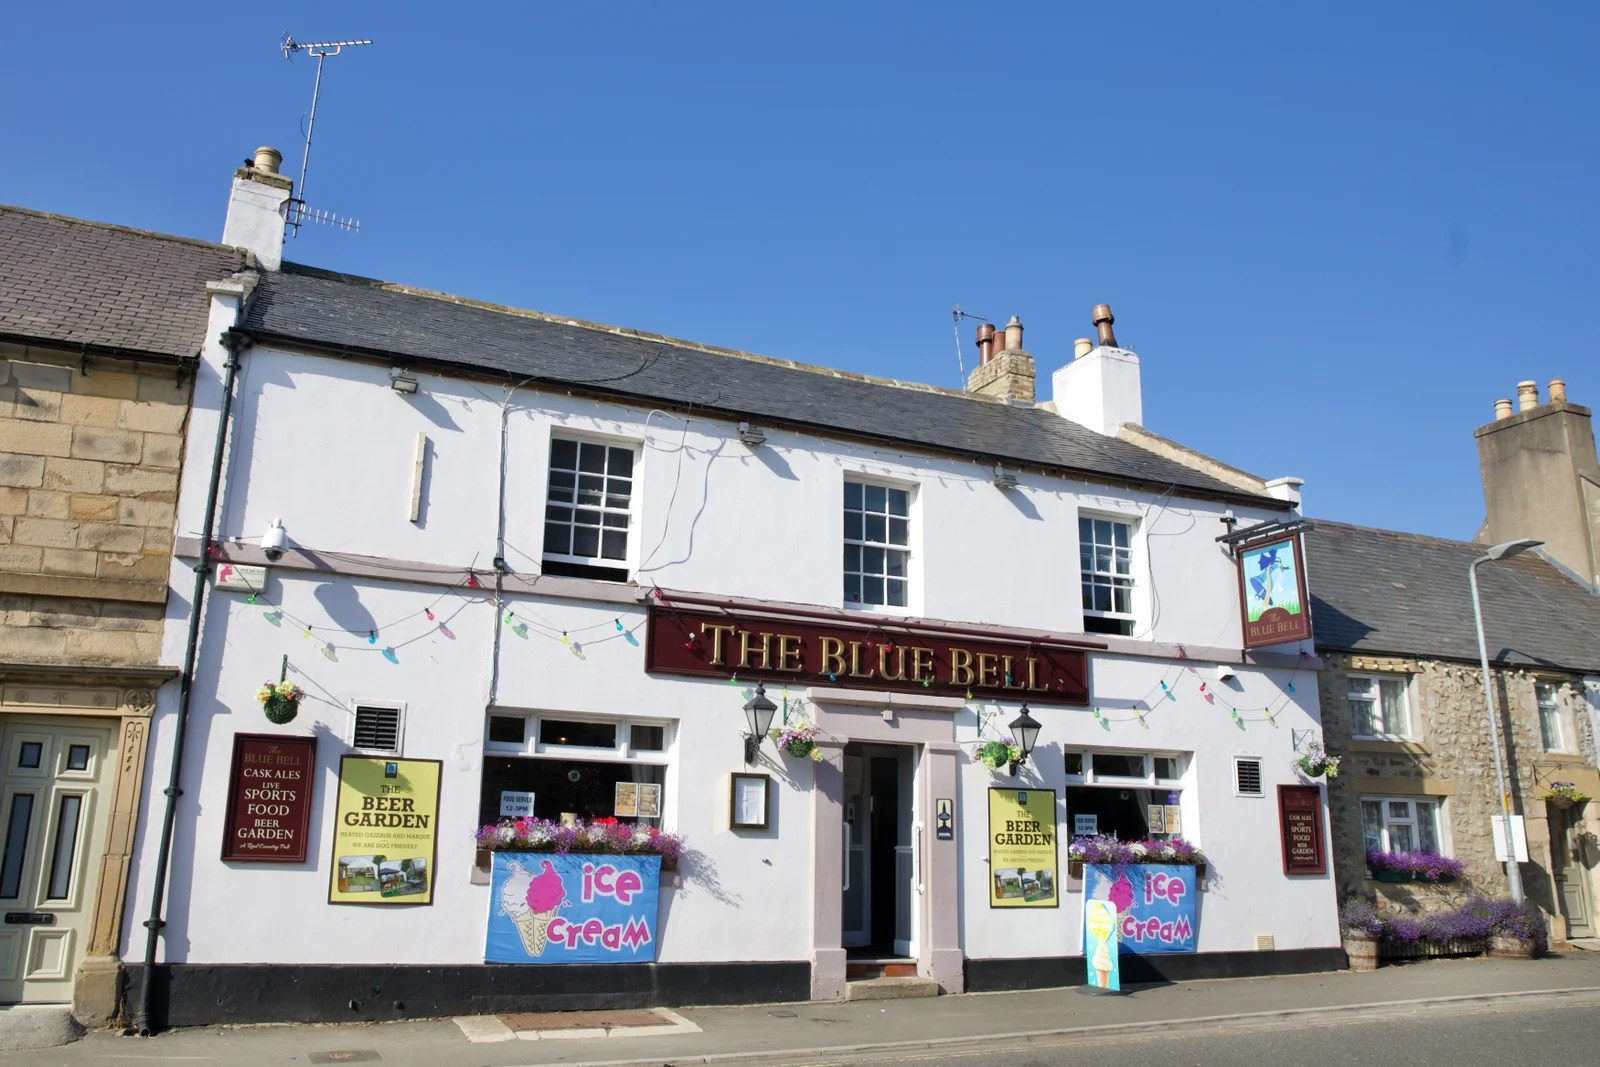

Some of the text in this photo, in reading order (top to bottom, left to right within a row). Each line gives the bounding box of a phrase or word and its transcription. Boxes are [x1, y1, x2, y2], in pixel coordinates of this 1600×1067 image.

[1250, 620, 1301, 637] BLUE BELL
[701, 622, 1049, 692] THE BLUE BELL
[244, 752, 302, 765] BLUE BELL
[243, 768, 301, 780] CASK ALES
[262, 781, 280, 789] LIVE
[381, 784, 401, 794] THE
[244, 788, 296, 801] SPORTS
[247, 803, 290, 816] FOOD
[361, 796, 415, 812] BEER
[344, 811, 430, 829] GARDEN
[1017, 810, 1031, 818] THE
[254, 818, 279, 828] BEER
[1005, 820, 1041, 833] BEER
[237, 827, 294, 840] GARDEN
[995, 832, 1052, 846] GARDEN
